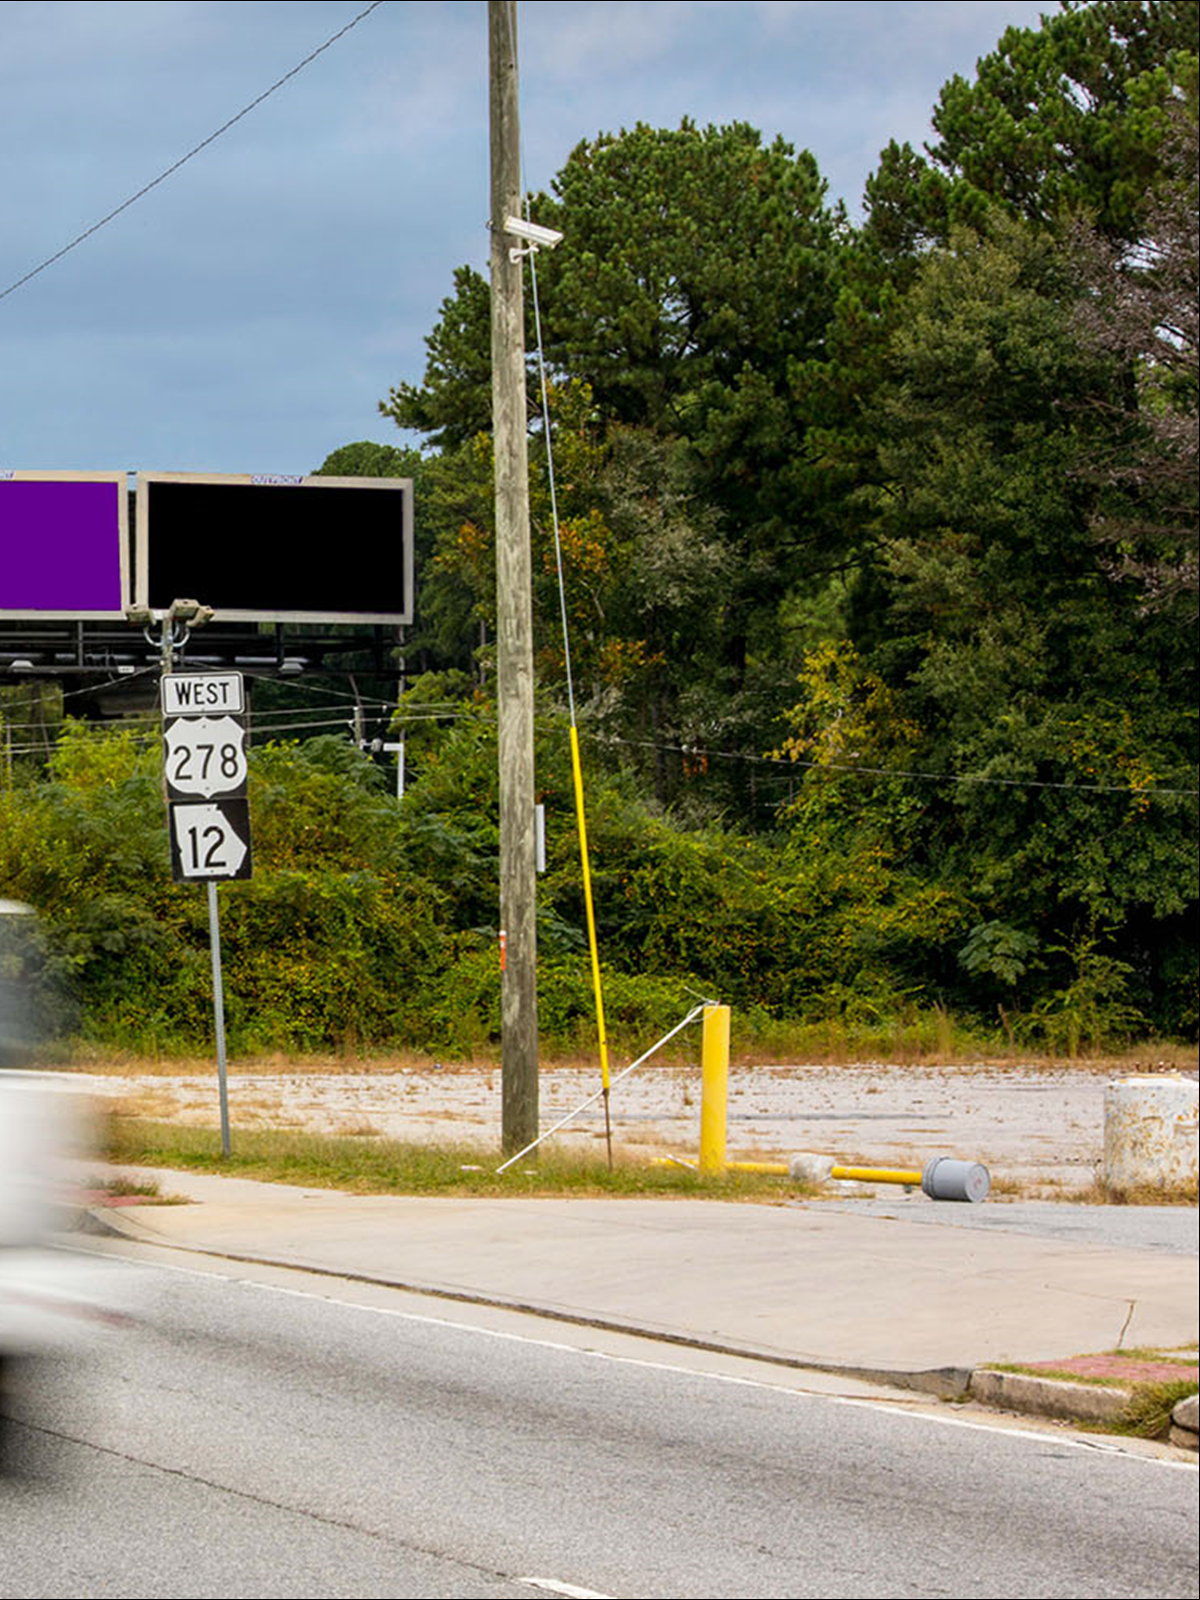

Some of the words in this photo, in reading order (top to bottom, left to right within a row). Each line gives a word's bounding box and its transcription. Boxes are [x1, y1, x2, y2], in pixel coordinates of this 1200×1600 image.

[174, 682, 230, 705] WEST
[173, 743, 239, 780] 278
[188, 825, 227, 869] 12
